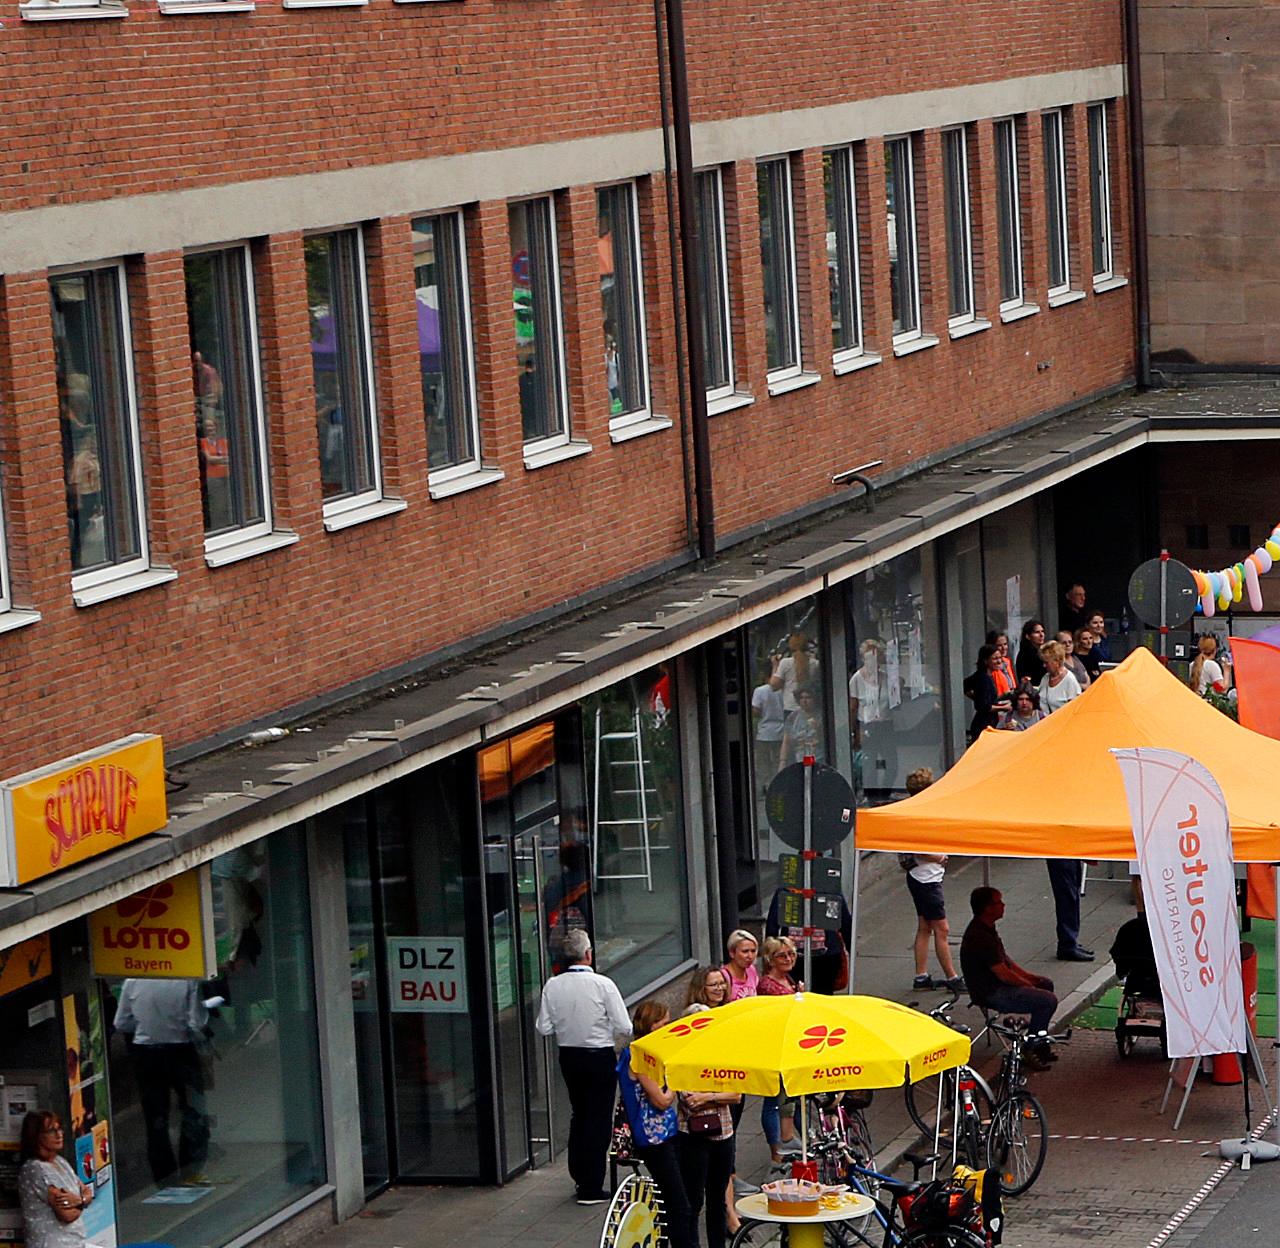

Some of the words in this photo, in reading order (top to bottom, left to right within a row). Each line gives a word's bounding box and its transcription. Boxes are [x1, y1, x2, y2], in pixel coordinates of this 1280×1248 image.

[45, 764, 138, 868] SCHRAUF
[103, 926, 190, 950] LOTTO
[124, 957, 173, 971] Bayern
[399, 948, 455, 970] DLZ
[401, 981, 456, 1001] BAU
[713, 1069, 746, 1080] LOTTO
[826, 1066, 862, 1077] LOTTO
